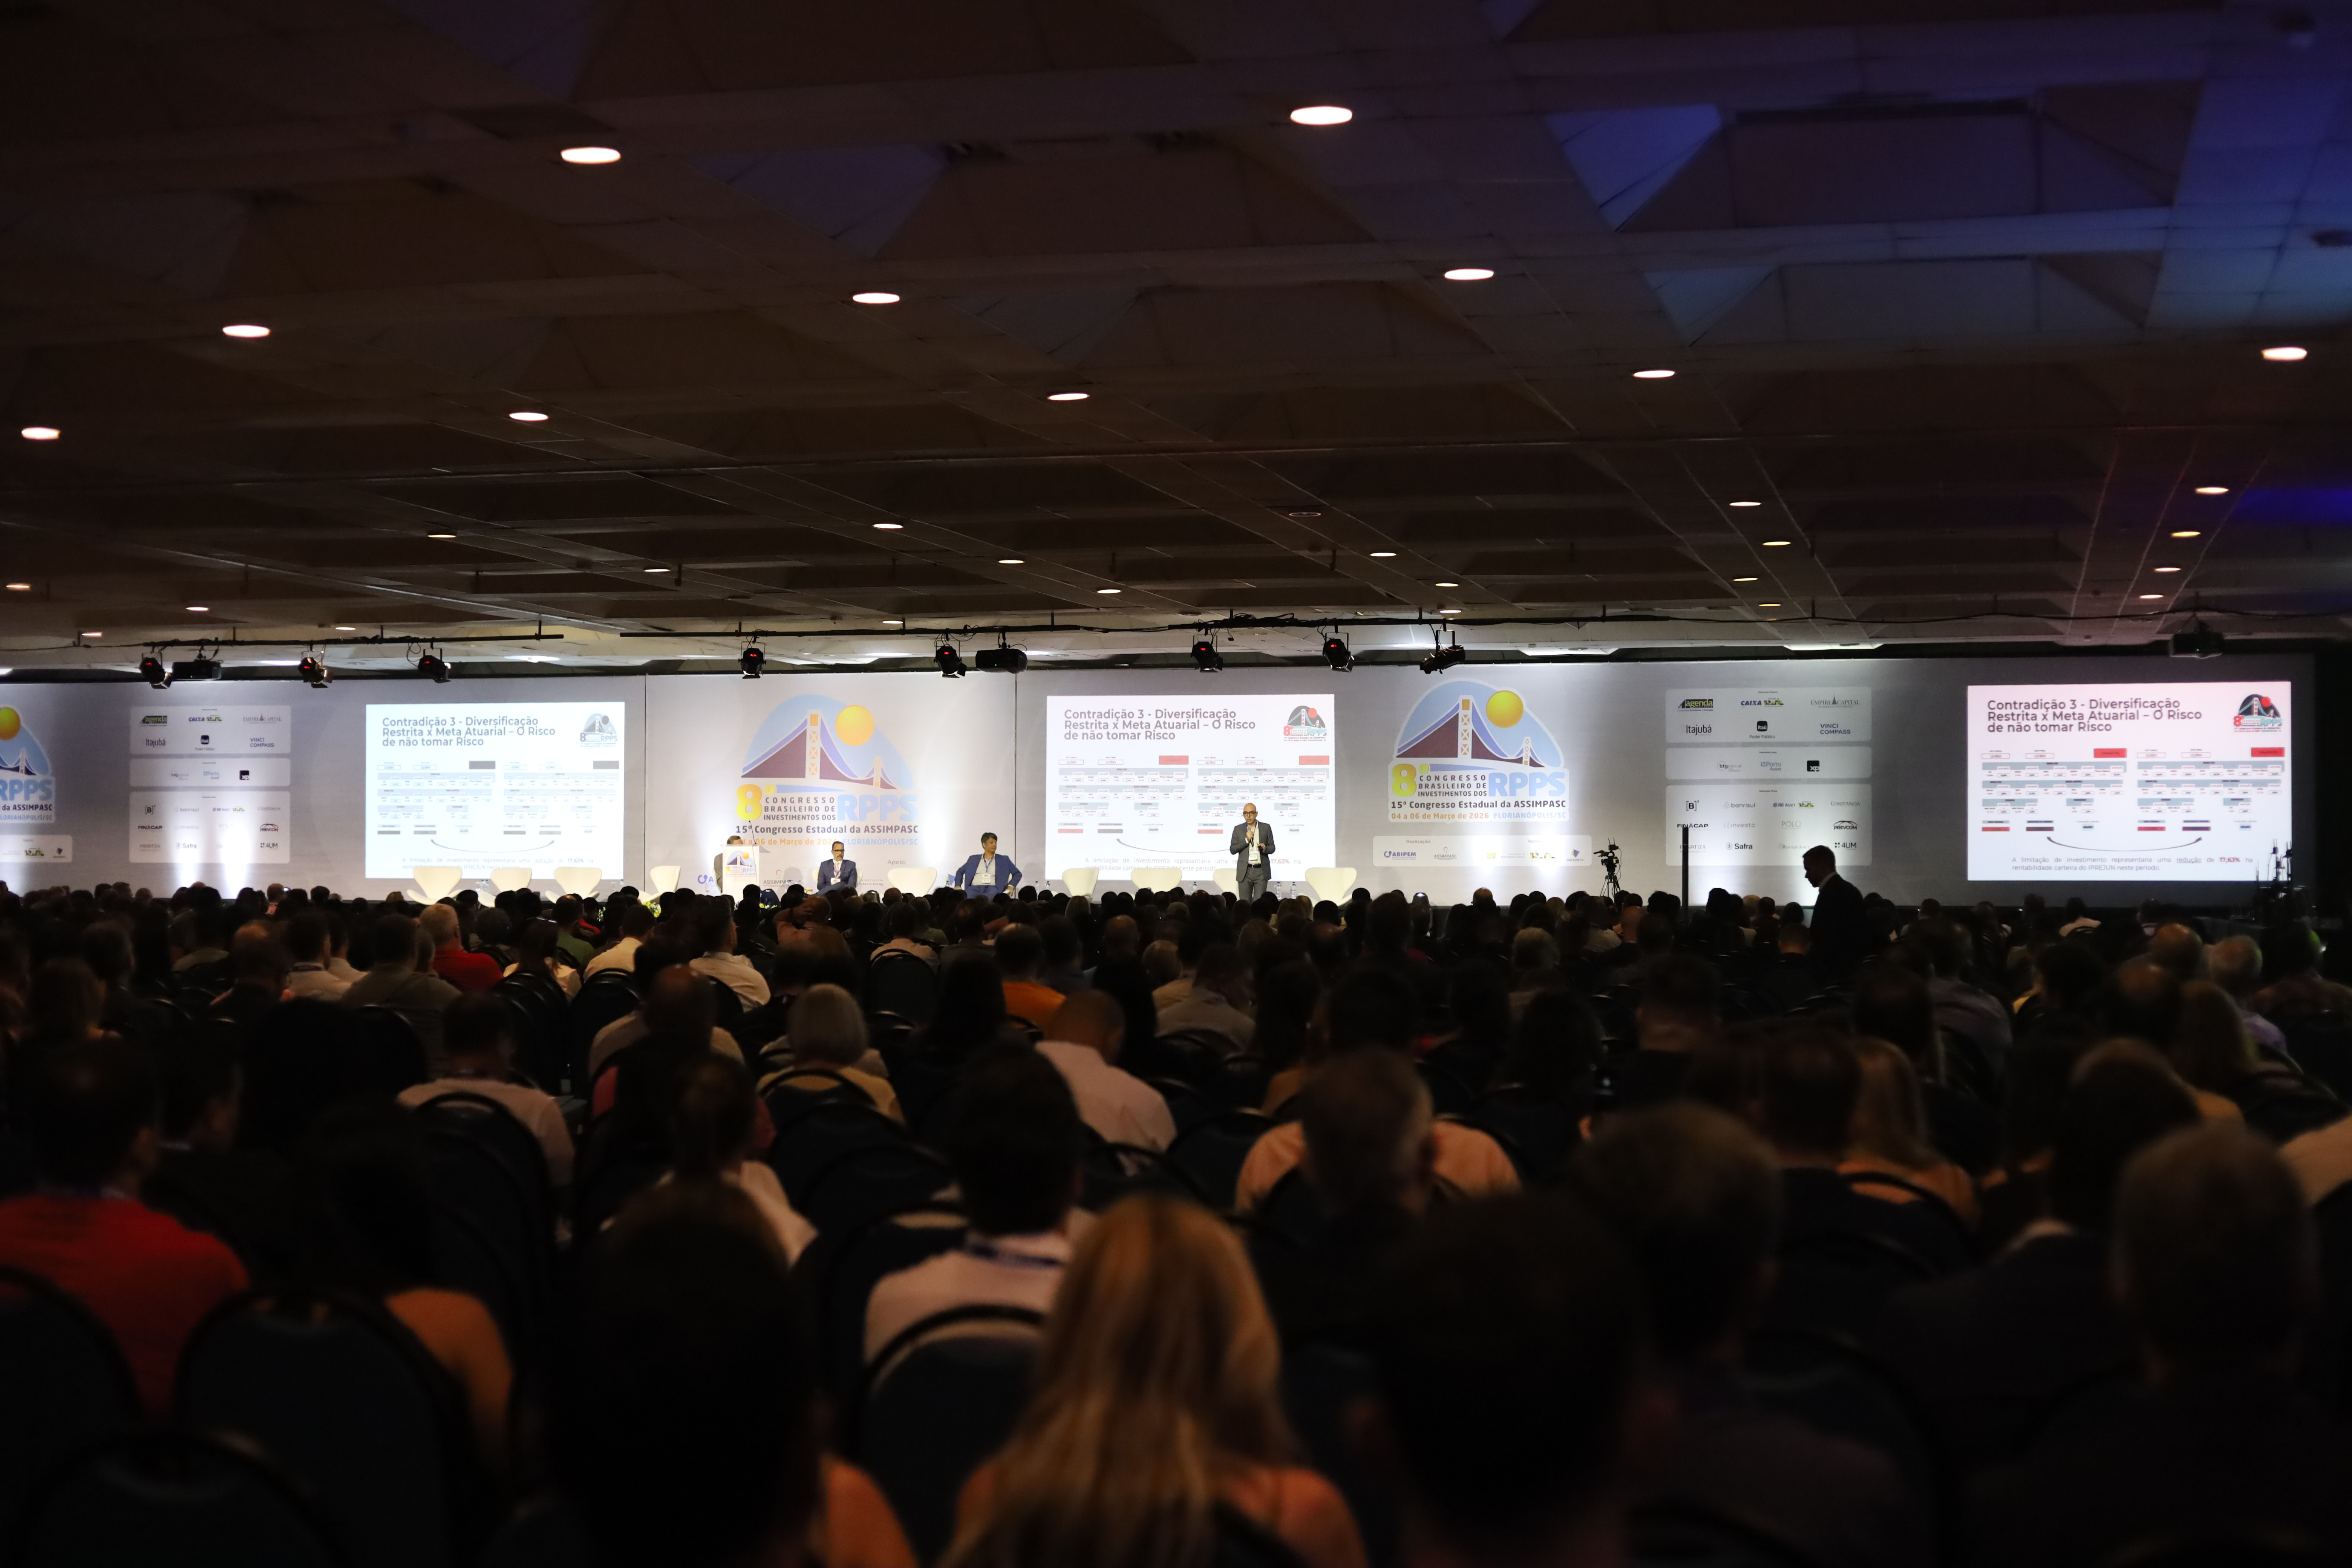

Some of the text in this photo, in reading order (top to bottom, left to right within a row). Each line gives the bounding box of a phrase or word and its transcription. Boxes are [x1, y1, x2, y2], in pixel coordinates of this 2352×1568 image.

[1686, 699, 1713, 708] agenda
[1988, 698, 2180, 712] Contradição 3 Diversificação
[1064, 708, 1236, 721] Contradição 3 Diversificação
[1988, 710, 2038, 721] Restrita
[2053, 711, 2084, 721] Meta
[2087, 709, 2139, 720] Atuarial
[2153, 710, 2163, 720] O
[2168, 709, 2202, 720] Risco
[383, 716, 538, 727] Contradição 3 Diversificação
[1065, 720, 1109, 730] Restrita
[1123, 720, 1151, 729] Meta
[1155, 719, 1200, 729] Atuarial
[1212, 720, 1221, 729] O
[1225, 719, 1256, 729] Risco
[1988, 720, 2112, 732] de não tomar Risco
[383, 727, 423, 737] Restrita
[436, 727, 462, 736] Meta
[465, 727, 505, 736] Atuarial
[517, 727, 525, 736] O
[528, 727, 555, 735] Risco
[1064, 730, 1176, 740] de não tomar Risco
[1686, 724, 1712, 735] Itajubá
[145, 738, 166, 747] Itajubá
[383, 736, 484, 746] de não tomar Risco
[1488, 772, 1566, 797] RPPS
[837, 794, 918, 821] RPPS
[1409, 801, 1456, 810] Congresso
[1433, 813, 1455, 821] Março
[755, 825, 803, 835] Congresso
[806, 825, 847, 833] Estadual
[850, 825, 861, 833] da
[864, 825, 918, 833] ASSIMPASC
